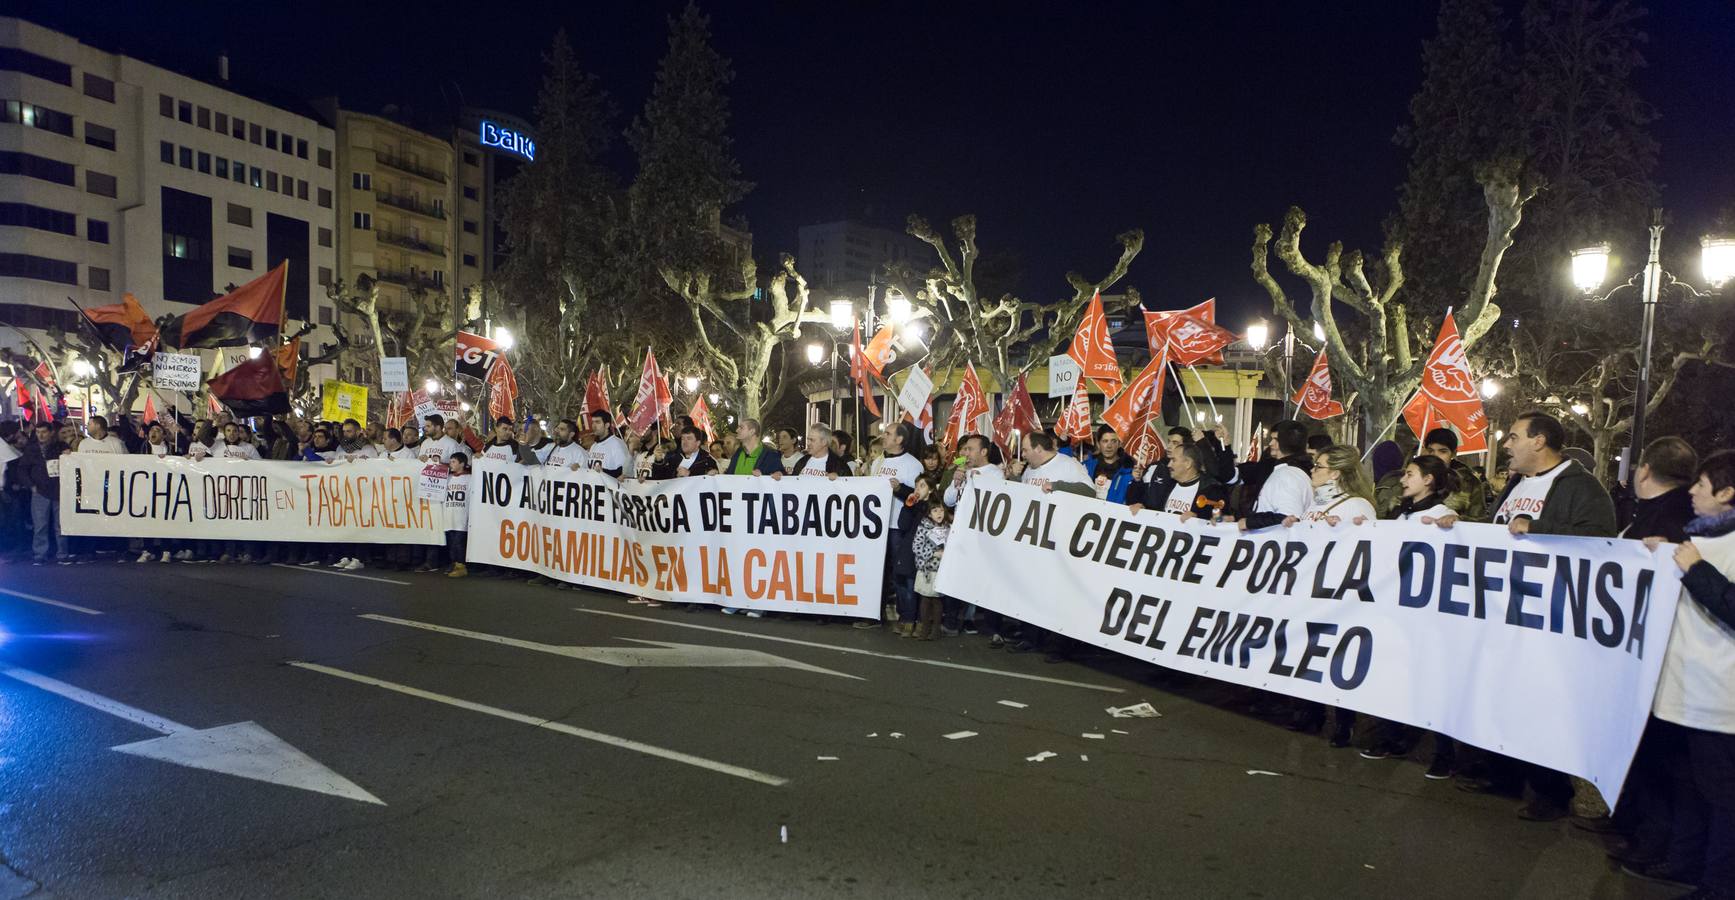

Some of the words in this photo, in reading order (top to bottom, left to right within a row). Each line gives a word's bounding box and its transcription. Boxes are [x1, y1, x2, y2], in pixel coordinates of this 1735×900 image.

[156, 355, 168, 363] NO
[1056, 371, 1072, 383] NO
[75, 467, 193, 522] LUCHA
[203, 473, 269, 521] OBRERA
[275, 487, 295, 511] EN
[300, 474, 433, 531] TABACALERA
[447, 490, 466, 502] NO
[481, 470, 512, 507] NO
[519, 476, 537, 511] AL
[538, 479, 606, 523] CIERRE
[699, 492, 732, 533] DE
[742, 492, 883, 540] TABACOS
[500, 519, 540, 565] 600
[542, 526, 649, 587] FAMILIAS
[651, 545, 688, 592] EN
[699, 546, 733, 598] LA
[743, 548, 859, 606] CALLE
[968, 487, 1012, 537] NO
[1014, 499, 1057, 551] AL
[1068, 512, 1221, 585] CIERRE
[1216, 539, 1309, 597] POR
[1311, 540, 1375, 603] LA
[1398, 540, 1656, 660] DEFENSA
[1099, 586, 1172, 651] DEL
[1177, 605, 1374, 691] EMPLEO
